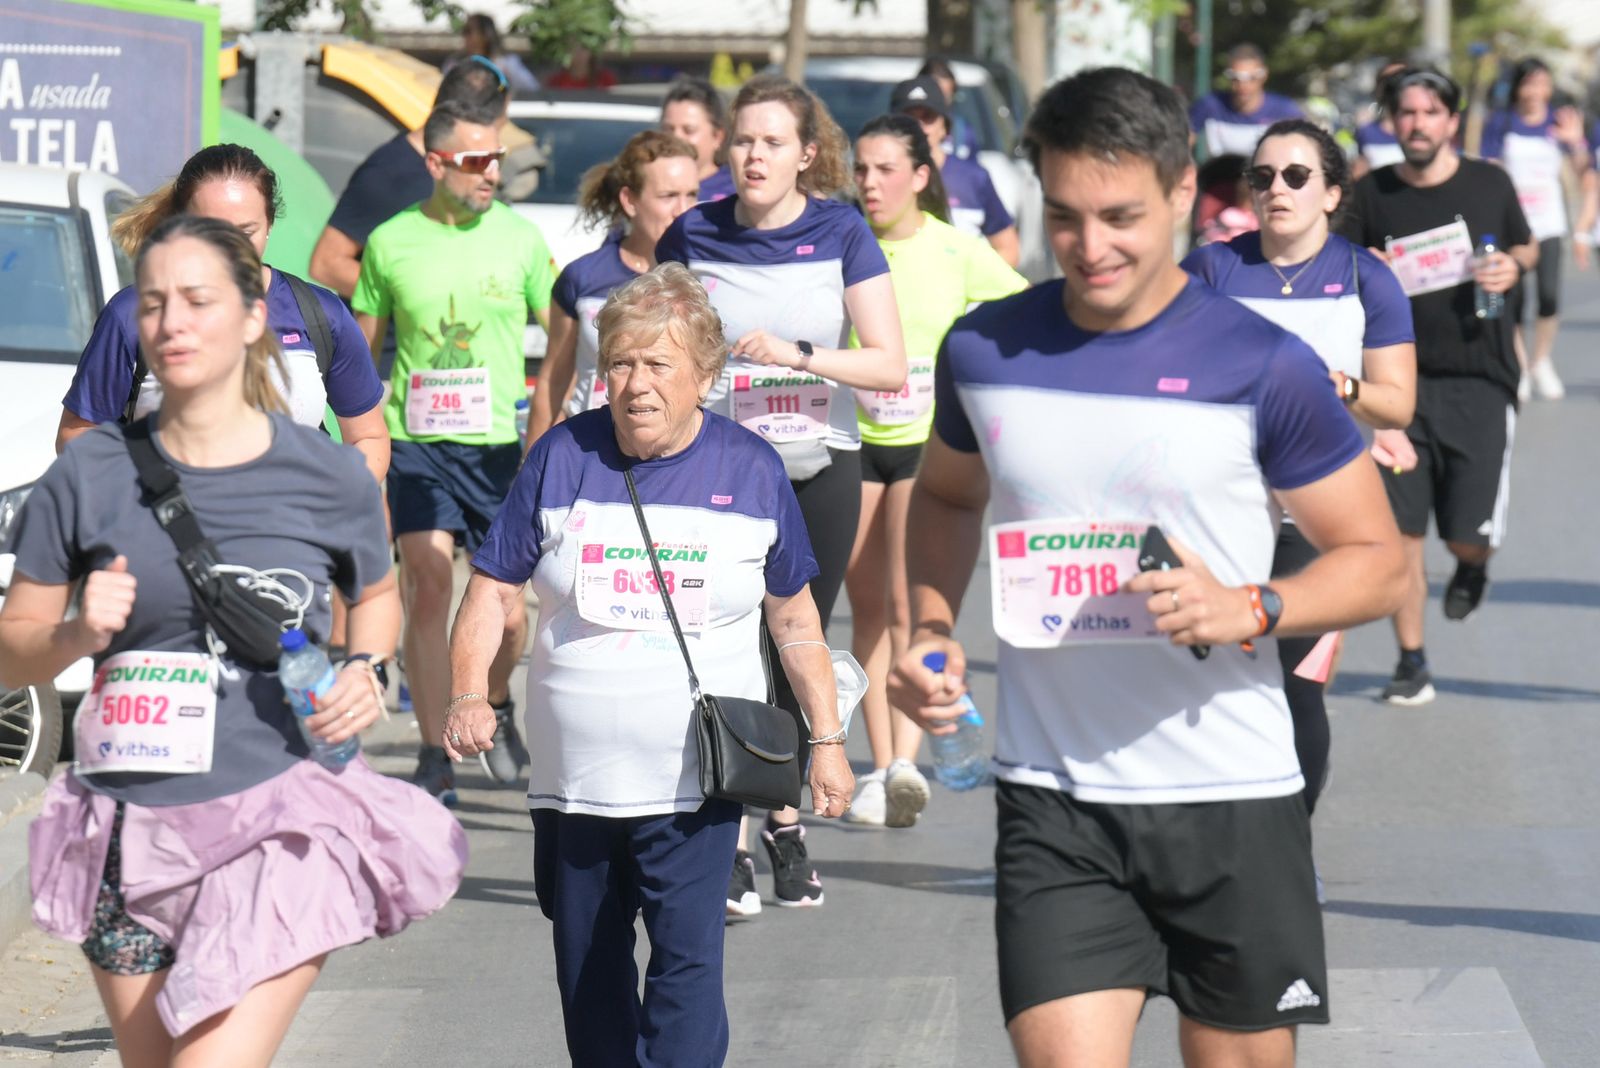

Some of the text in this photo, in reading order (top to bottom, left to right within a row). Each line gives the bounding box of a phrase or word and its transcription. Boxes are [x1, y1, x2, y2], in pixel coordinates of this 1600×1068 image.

[29, 72, 112, 110] usada
[10, 118, 119, 174] TELA
[421, 376, 485, 387] COVIRAN
[752, 375, 825, 388] COVIRAN
[431, 393, 461, 409] 246
[765, 394, 800, 413] 1111
[774, 424, 808, 434] vithas
[604, 547, 708, 562] COVRAN
[1047, 563, 1119, 597] 7818
[631, 607, 669, 620] vitha
[1070, 614, 1131, 631] vithas
[102, 694, 170, 725] 5062
[115, 740, 170, 757] vithas
